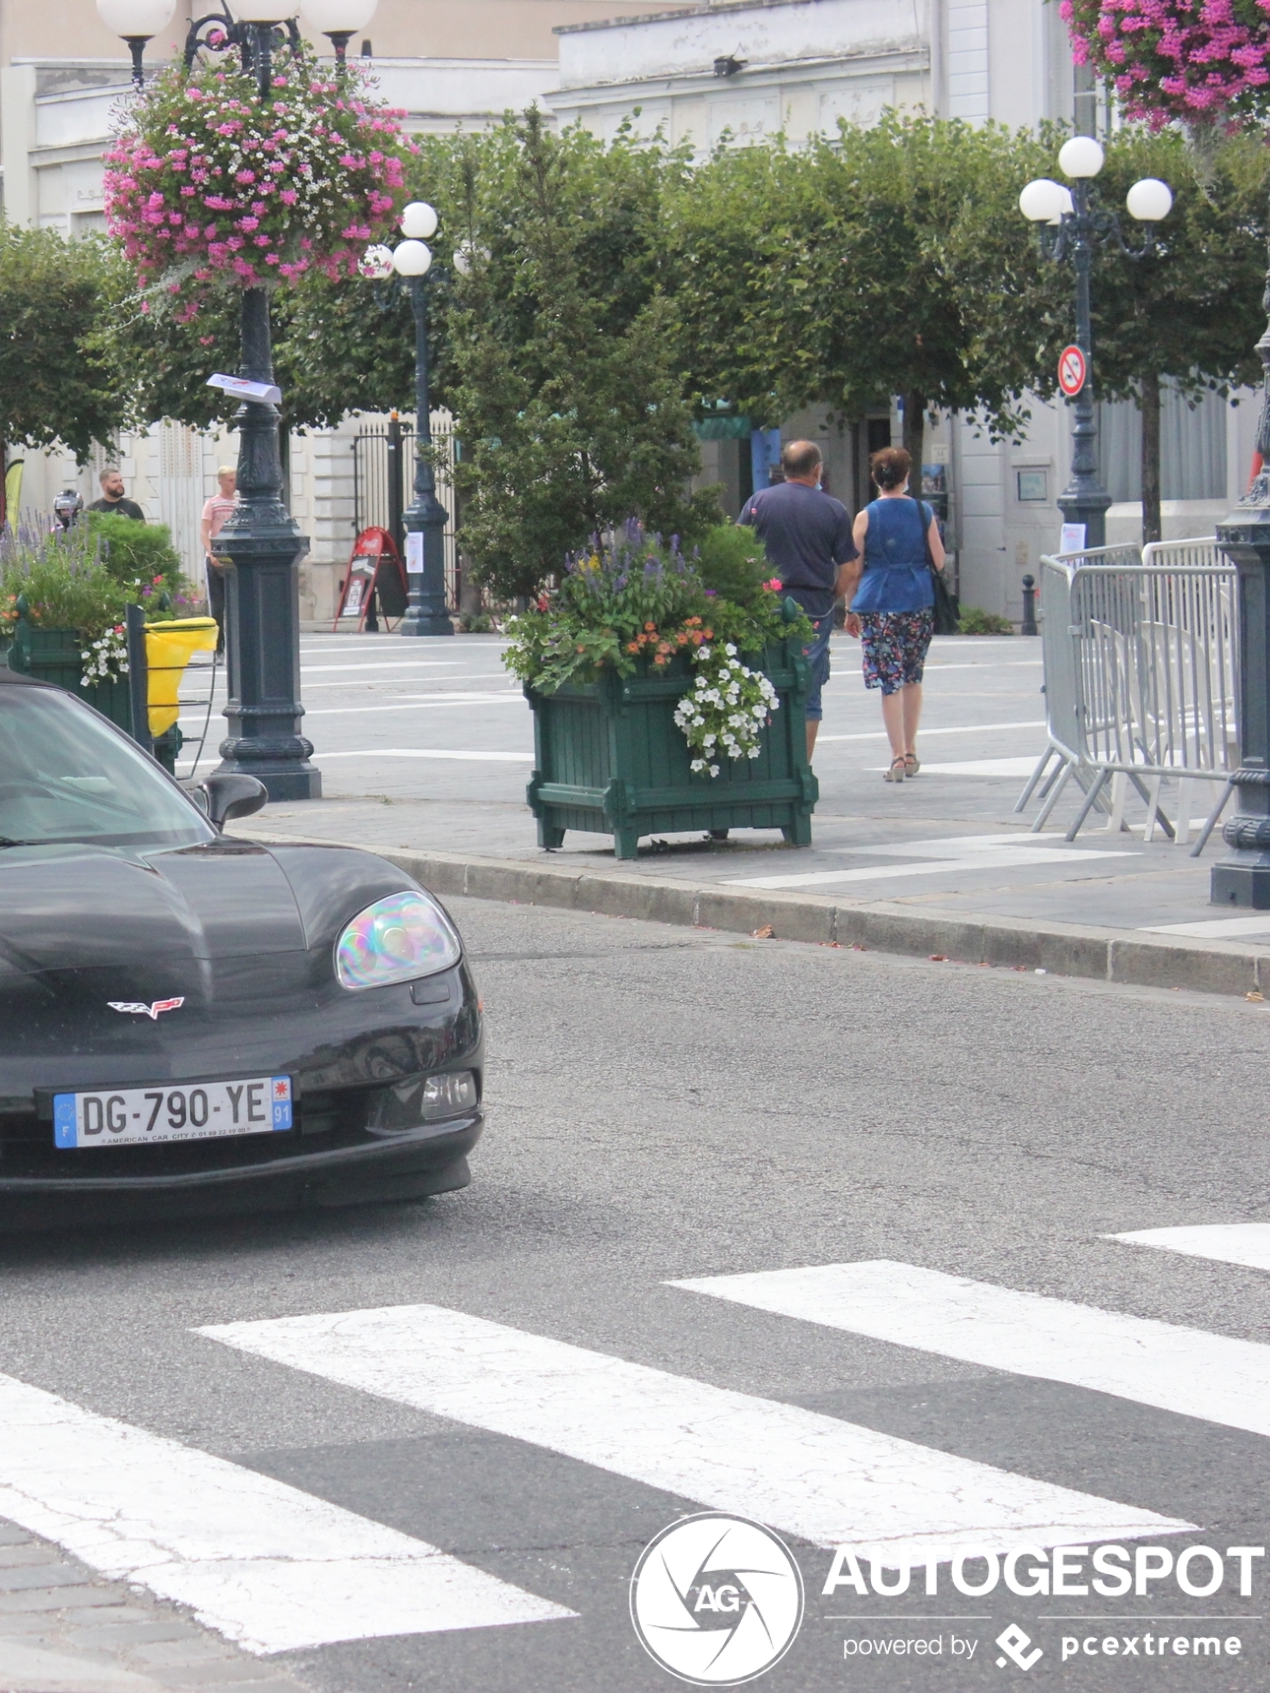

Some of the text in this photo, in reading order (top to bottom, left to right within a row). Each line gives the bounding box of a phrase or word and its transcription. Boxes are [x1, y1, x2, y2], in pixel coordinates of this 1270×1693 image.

[83, 1083, 266, 1135] DG-790-YE
[274, 1105, 289, 1123] 91
[62, 1125, 69, 1137] F
[107, 1136, 148, 1144] AMERICAN
